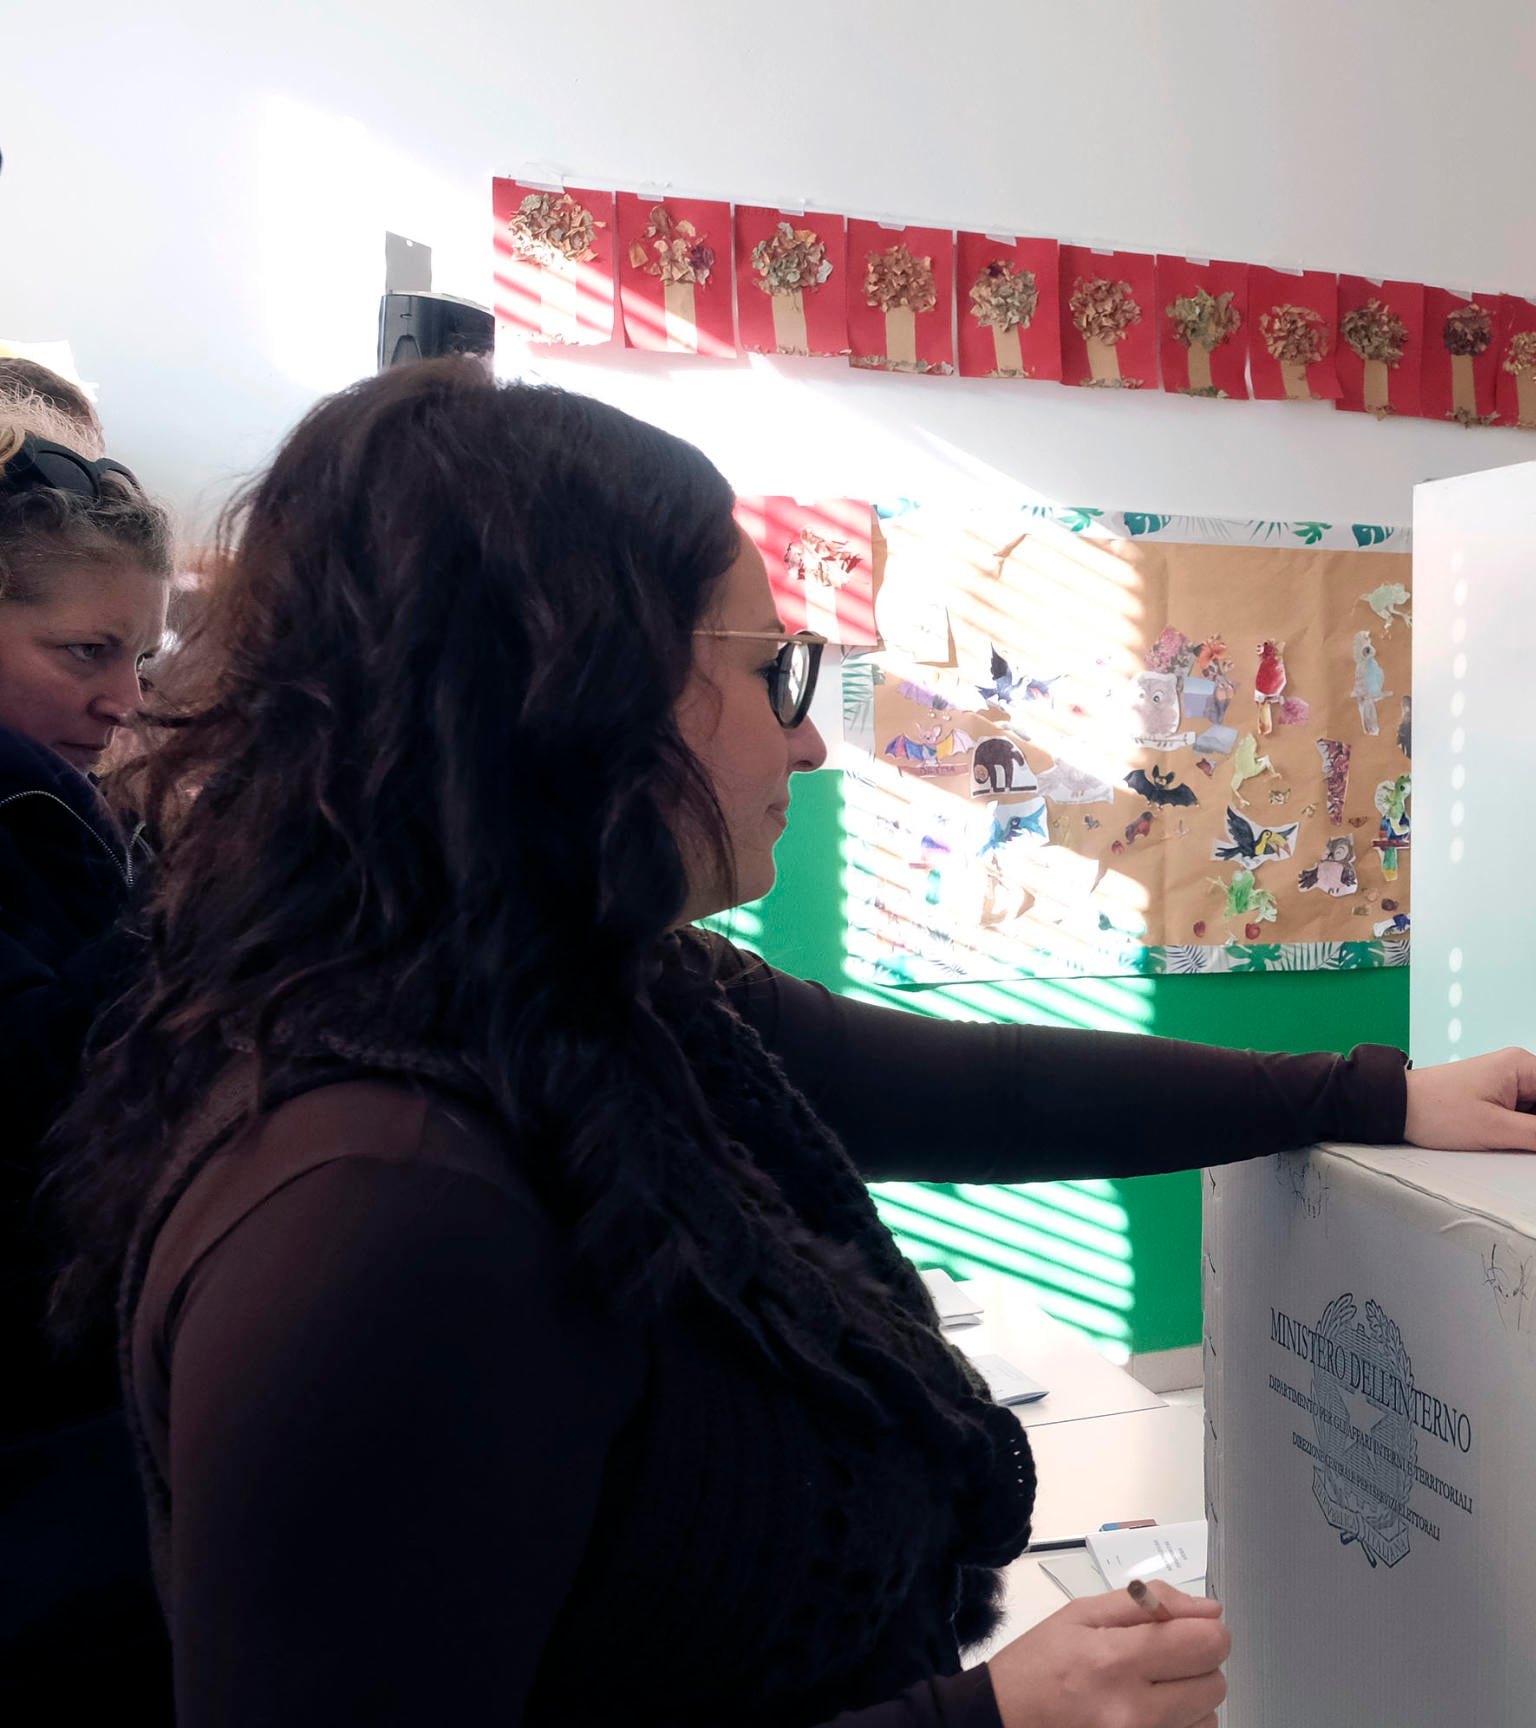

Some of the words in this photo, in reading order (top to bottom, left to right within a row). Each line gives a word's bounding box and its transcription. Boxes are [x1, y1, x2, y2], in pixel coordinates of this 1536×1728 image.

[1270, 1307, 1346, 1380] MINISTERO
[1350, 1352, 1472, 1453] DELL'INTERNO
[1414, 1465, 1473, 1514] TERRITORIALI
